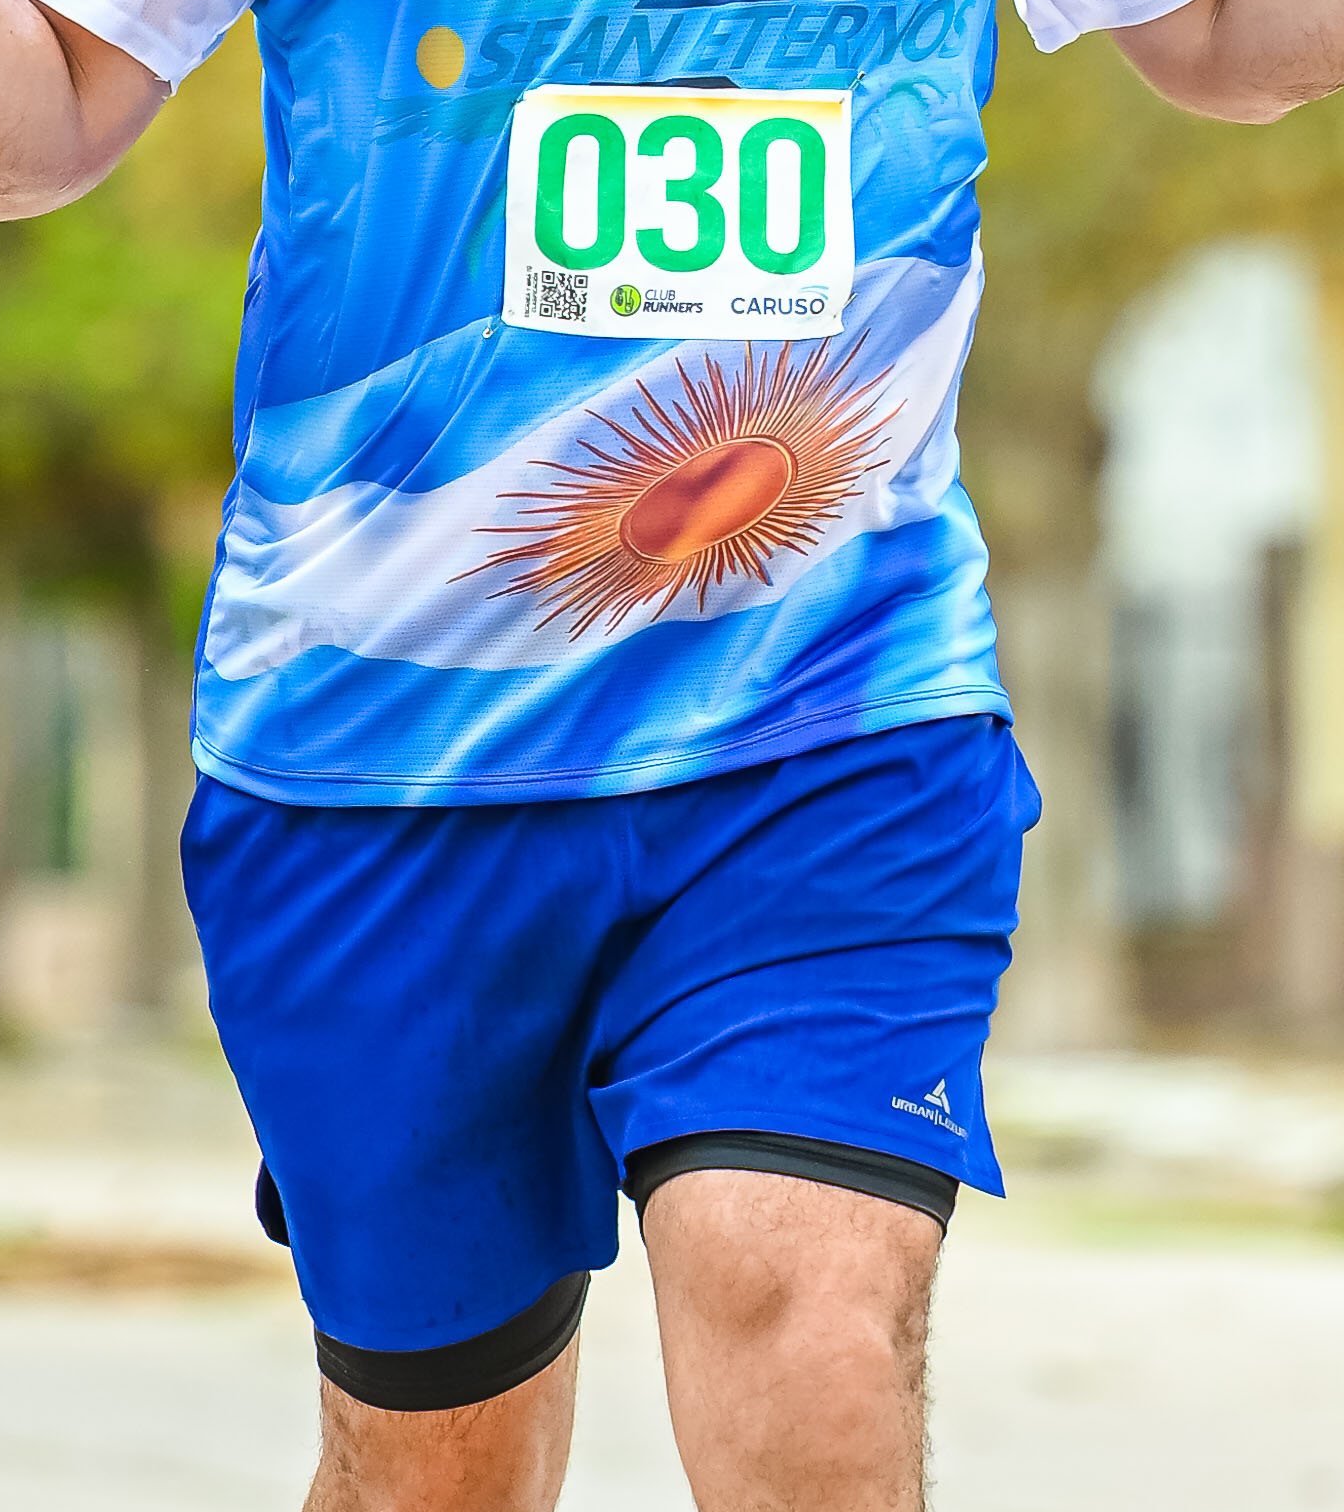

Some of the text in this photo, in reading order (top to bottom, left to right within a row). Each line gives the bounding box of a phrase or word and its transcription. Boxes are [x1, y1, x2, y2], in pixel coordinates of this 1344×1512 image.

[464, 12, 685, 88] SEAN
[534, 112, 826, 275] 030
[644, 289, 676, 301] CLUB
[642, 301, 704, 314] RUNNER'S
[730, 297, 826, 316] CARUSO
